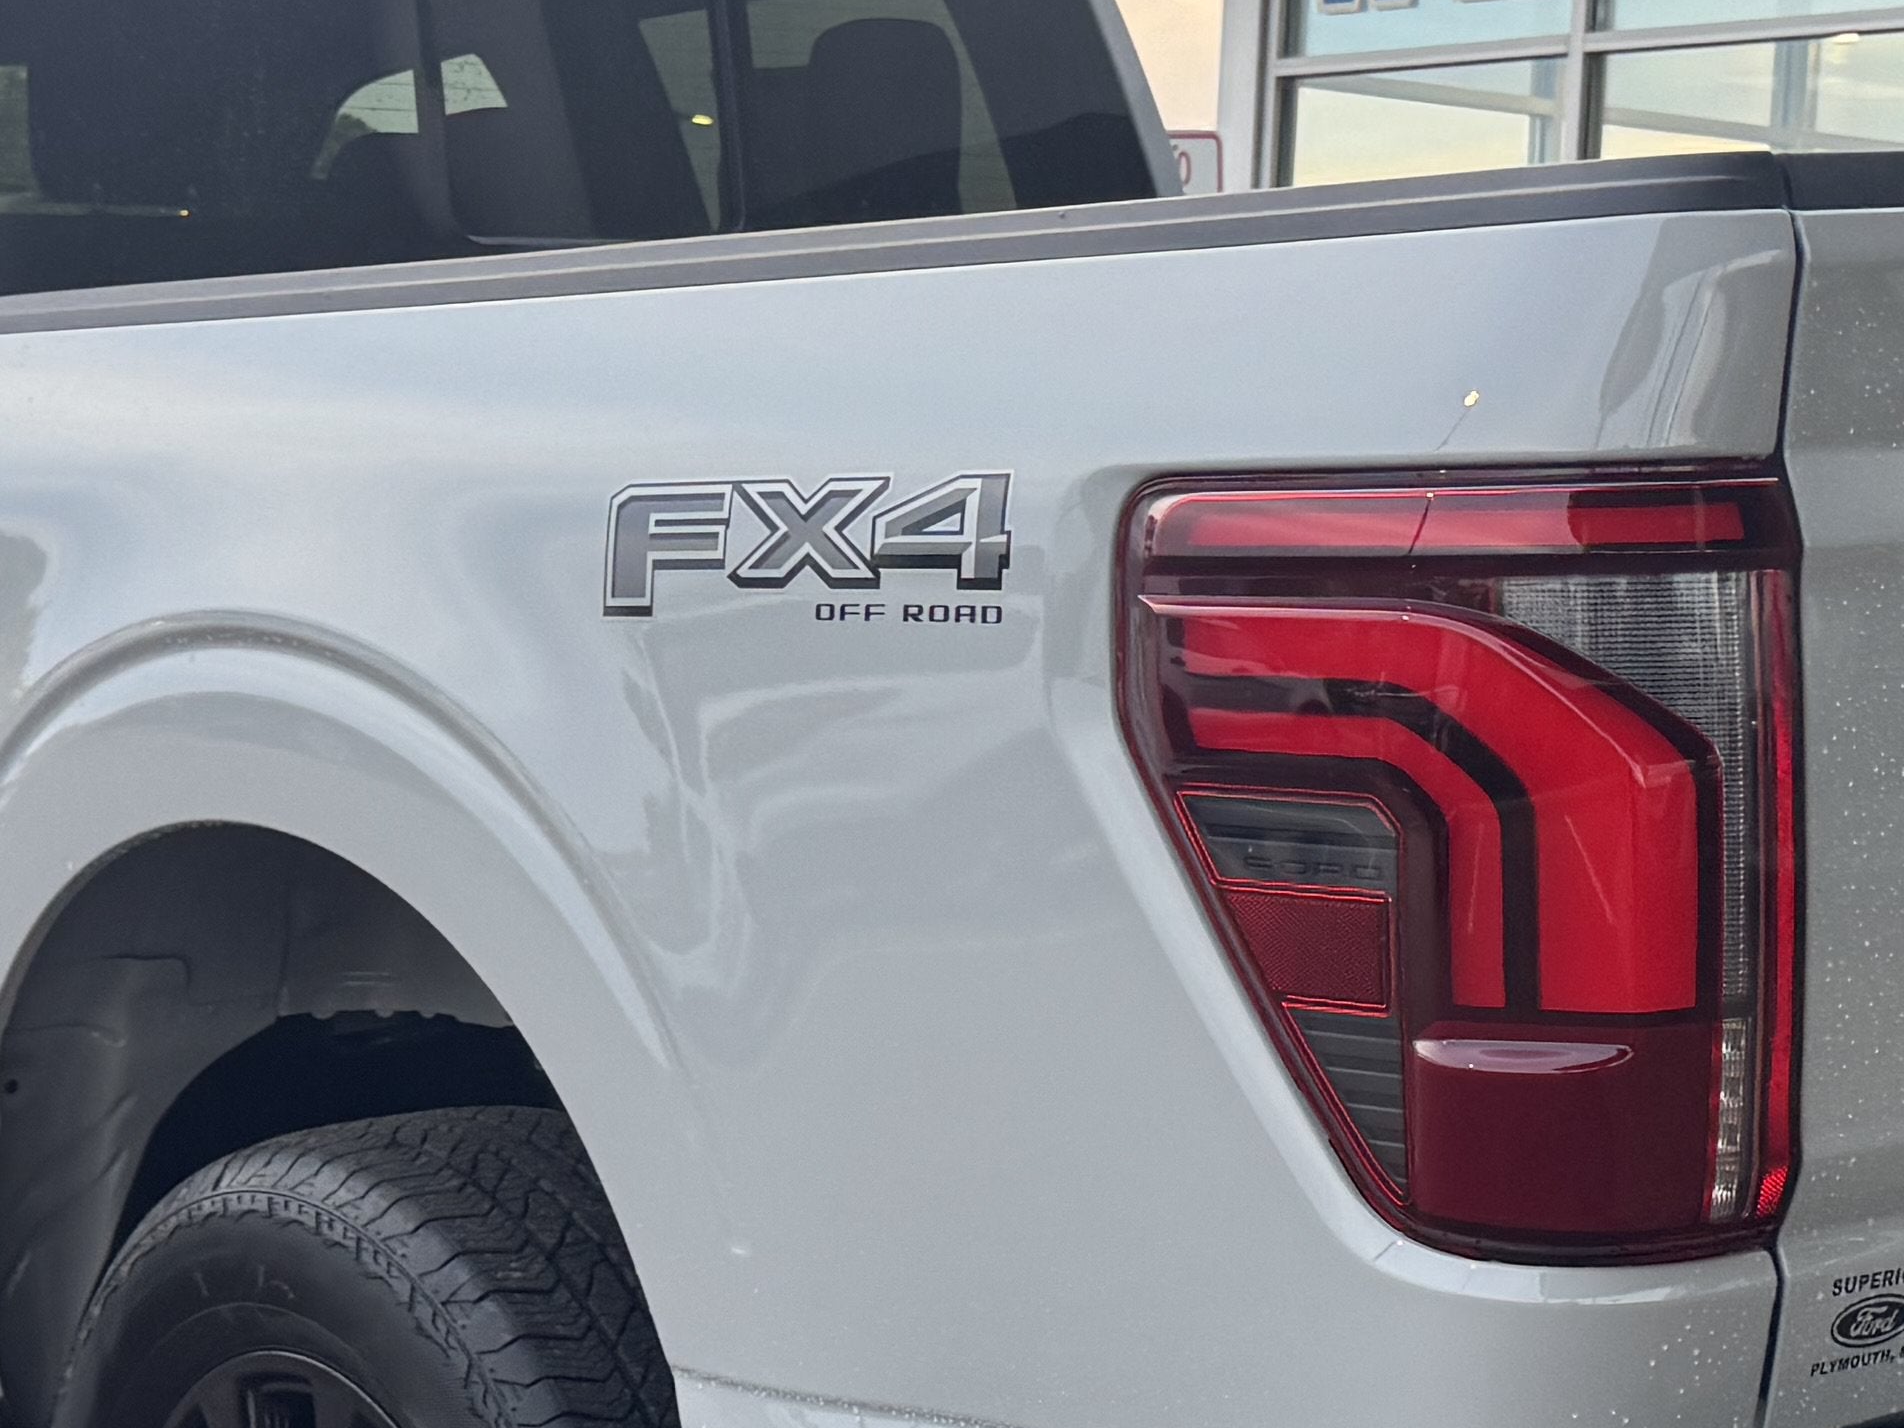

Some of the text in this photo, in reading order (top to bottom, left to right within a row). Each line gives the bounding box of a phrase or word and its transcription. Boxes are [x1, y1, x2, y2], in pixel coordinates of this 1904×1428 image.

[603, 470, 1015, 618] FX4
[814, 602, 1003, 625] OFF ROAD
[1850, 1305, 1899, 1338] Ford
